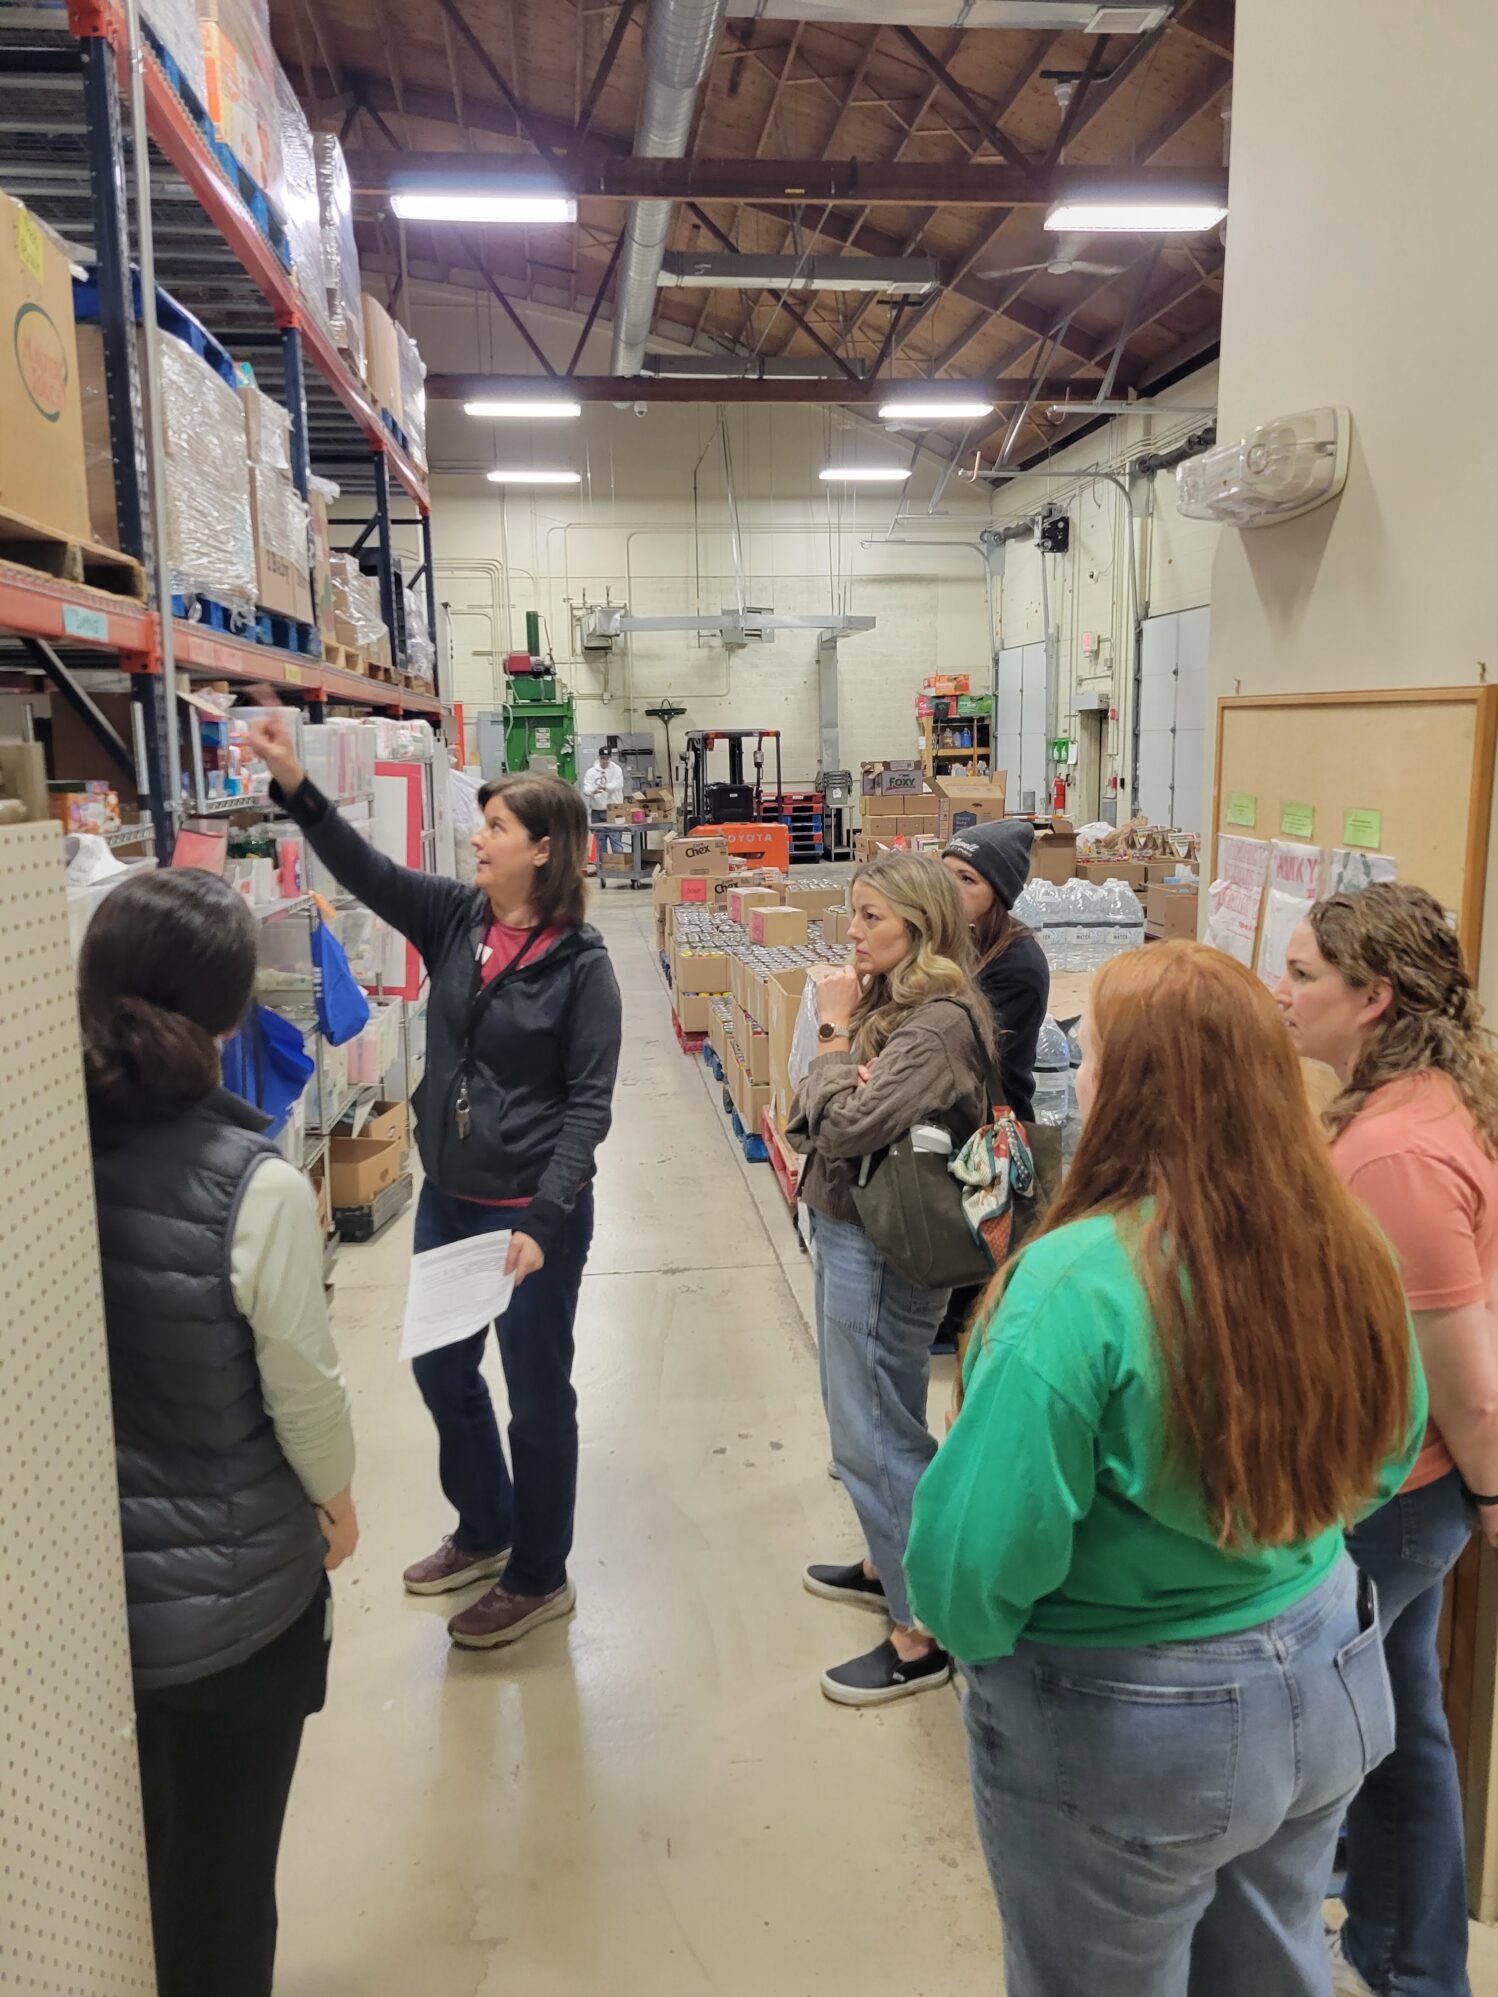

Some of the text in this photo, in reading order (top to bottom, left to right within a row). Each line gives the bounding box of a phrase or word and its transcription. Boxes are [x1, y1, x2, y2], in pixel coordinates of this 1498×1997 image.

[889, 776, 916, 787] FOXY
[728, 834, 773, 842] OYOTA
[685, 845, 711, 858] Chex
[714, 881, 739, 895] Chex
